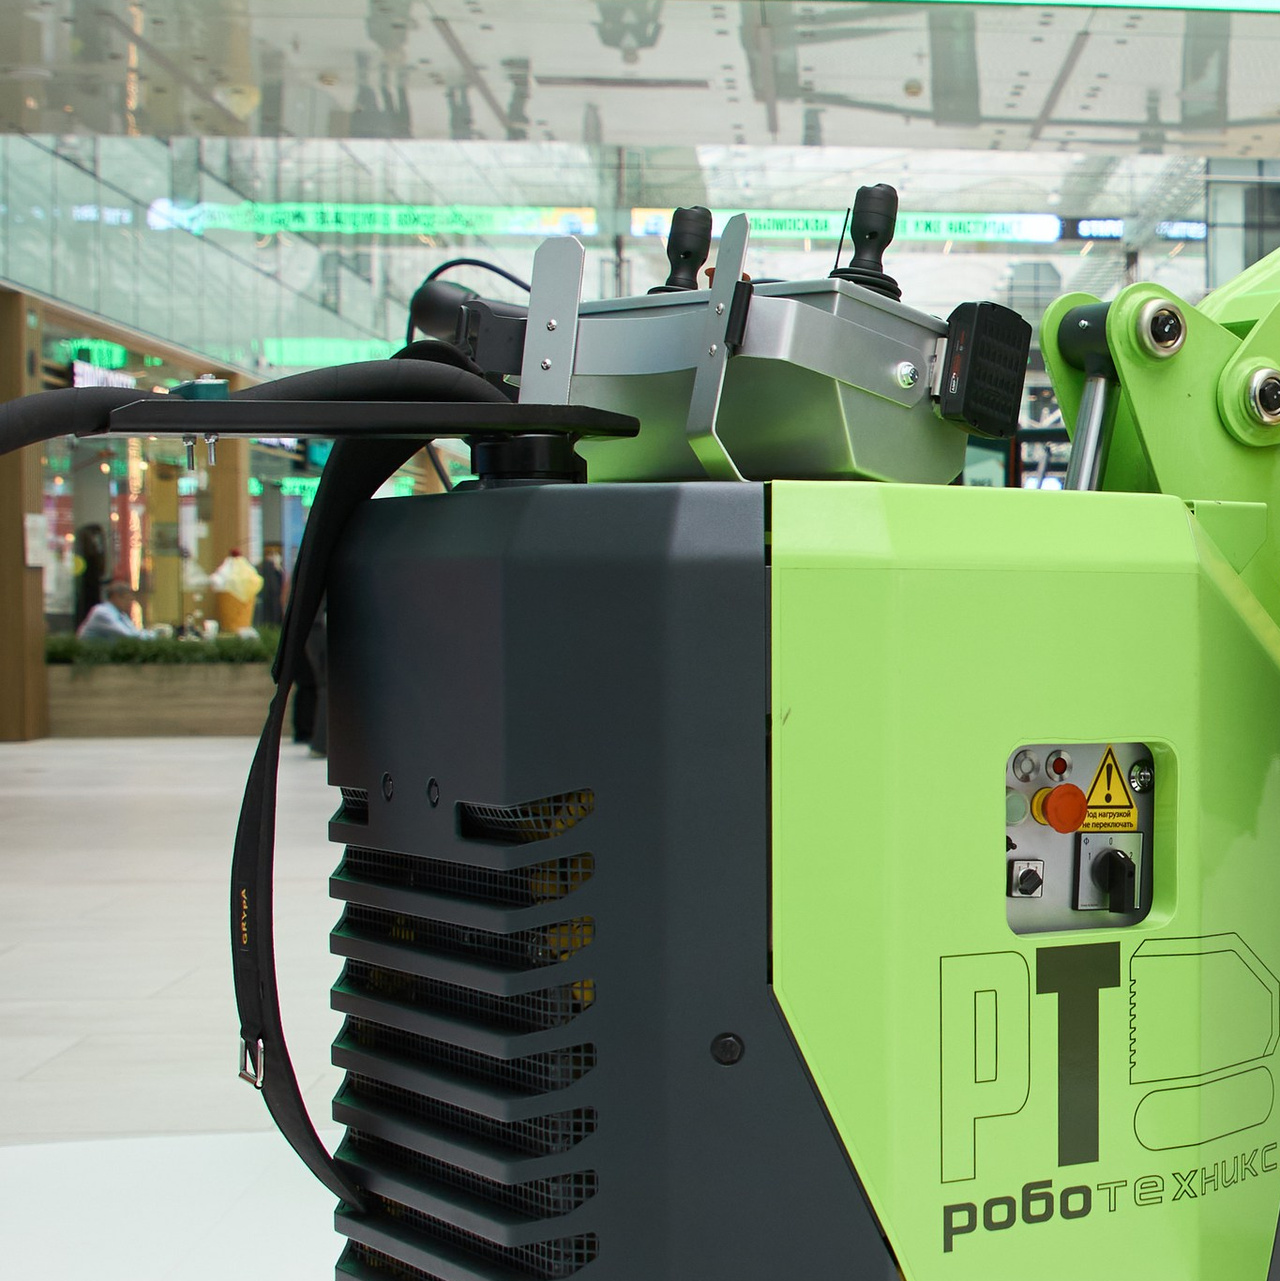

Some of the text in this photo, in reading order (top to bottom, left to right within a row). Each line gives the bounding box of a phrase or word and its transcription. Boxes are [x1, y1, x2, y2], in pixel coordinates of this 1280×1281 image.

[1098, 810, 1132, 820] нагрузкой
[1091, 822, 1134, 830] переключать
[943, 1141, 1278, 1254] роботехникс
